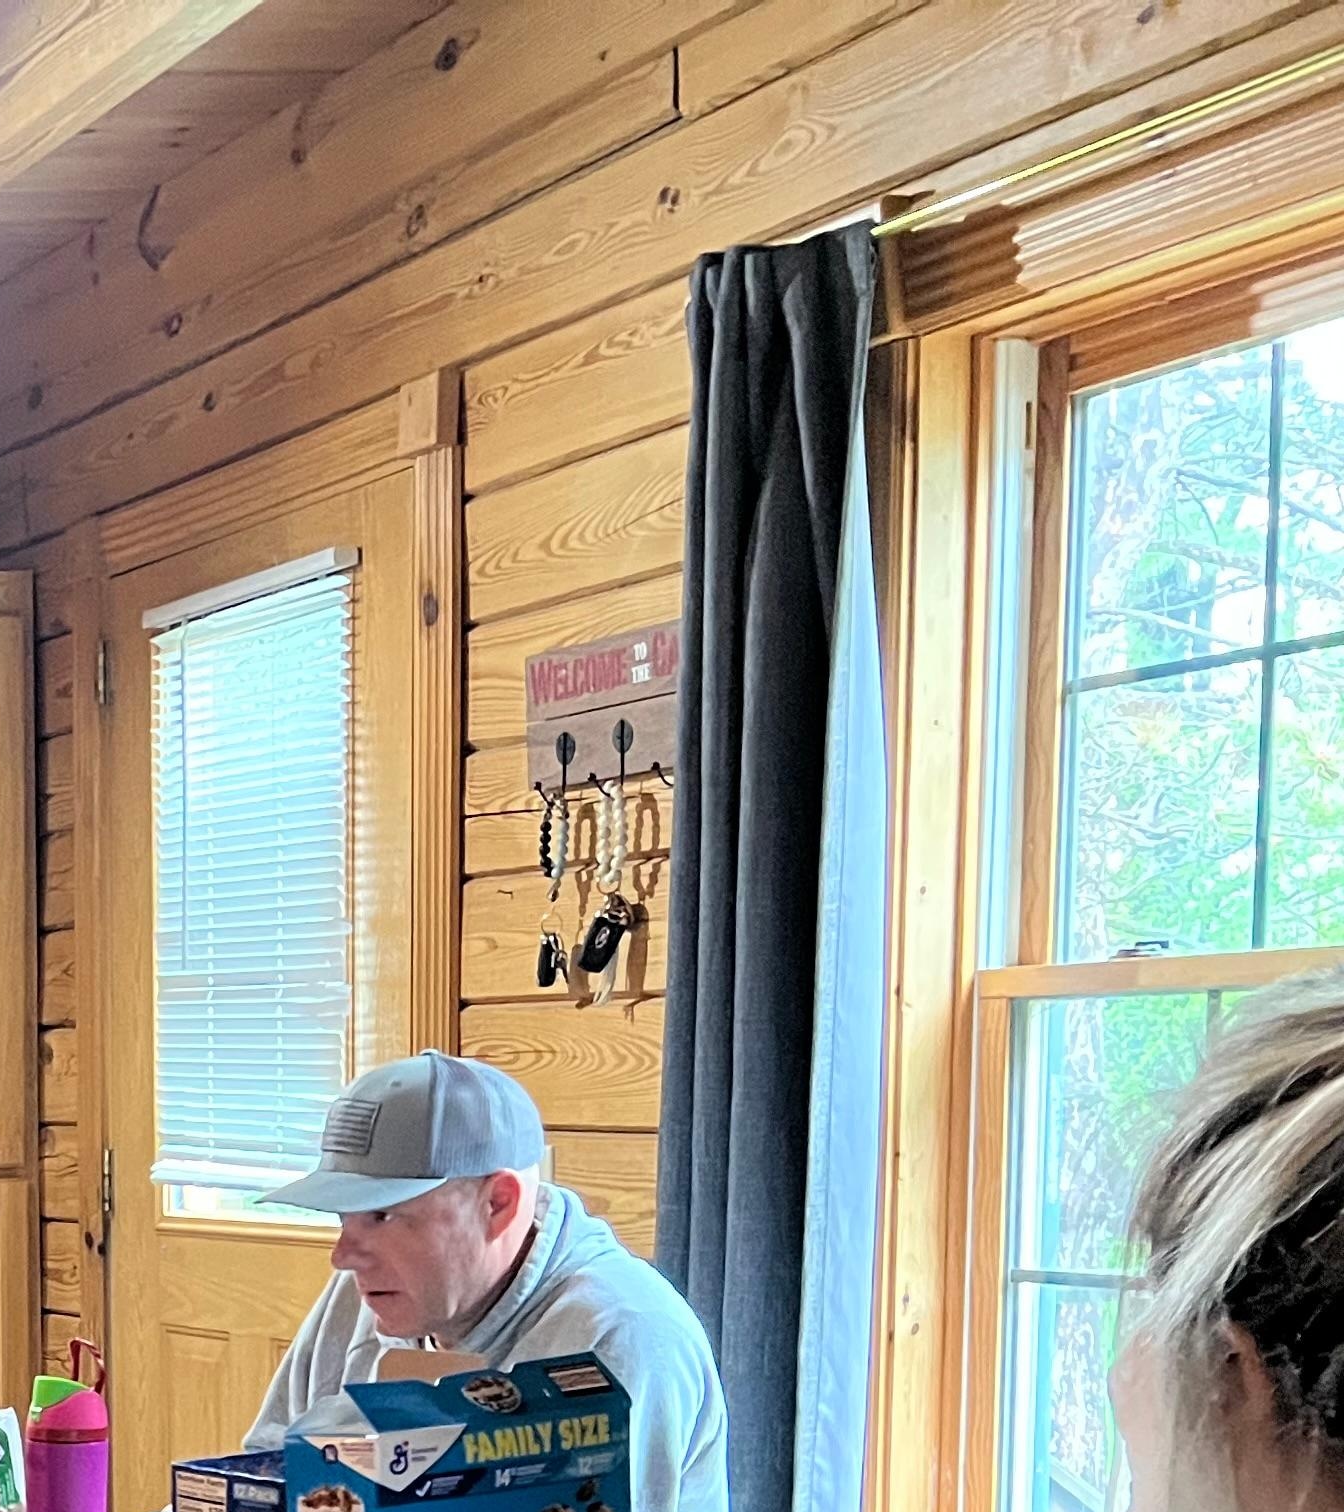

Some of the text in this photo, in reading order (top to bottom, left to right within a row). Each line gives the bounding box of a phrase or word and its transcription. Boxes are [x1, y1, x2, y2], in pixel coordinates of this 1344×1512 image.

[633, 641, 648, 661] TO
[530, 647, 628, 706] WELCOME
[631, 662, 652, 684] THE
[462, 1413, 611, 1464] FAMILY SIZE
